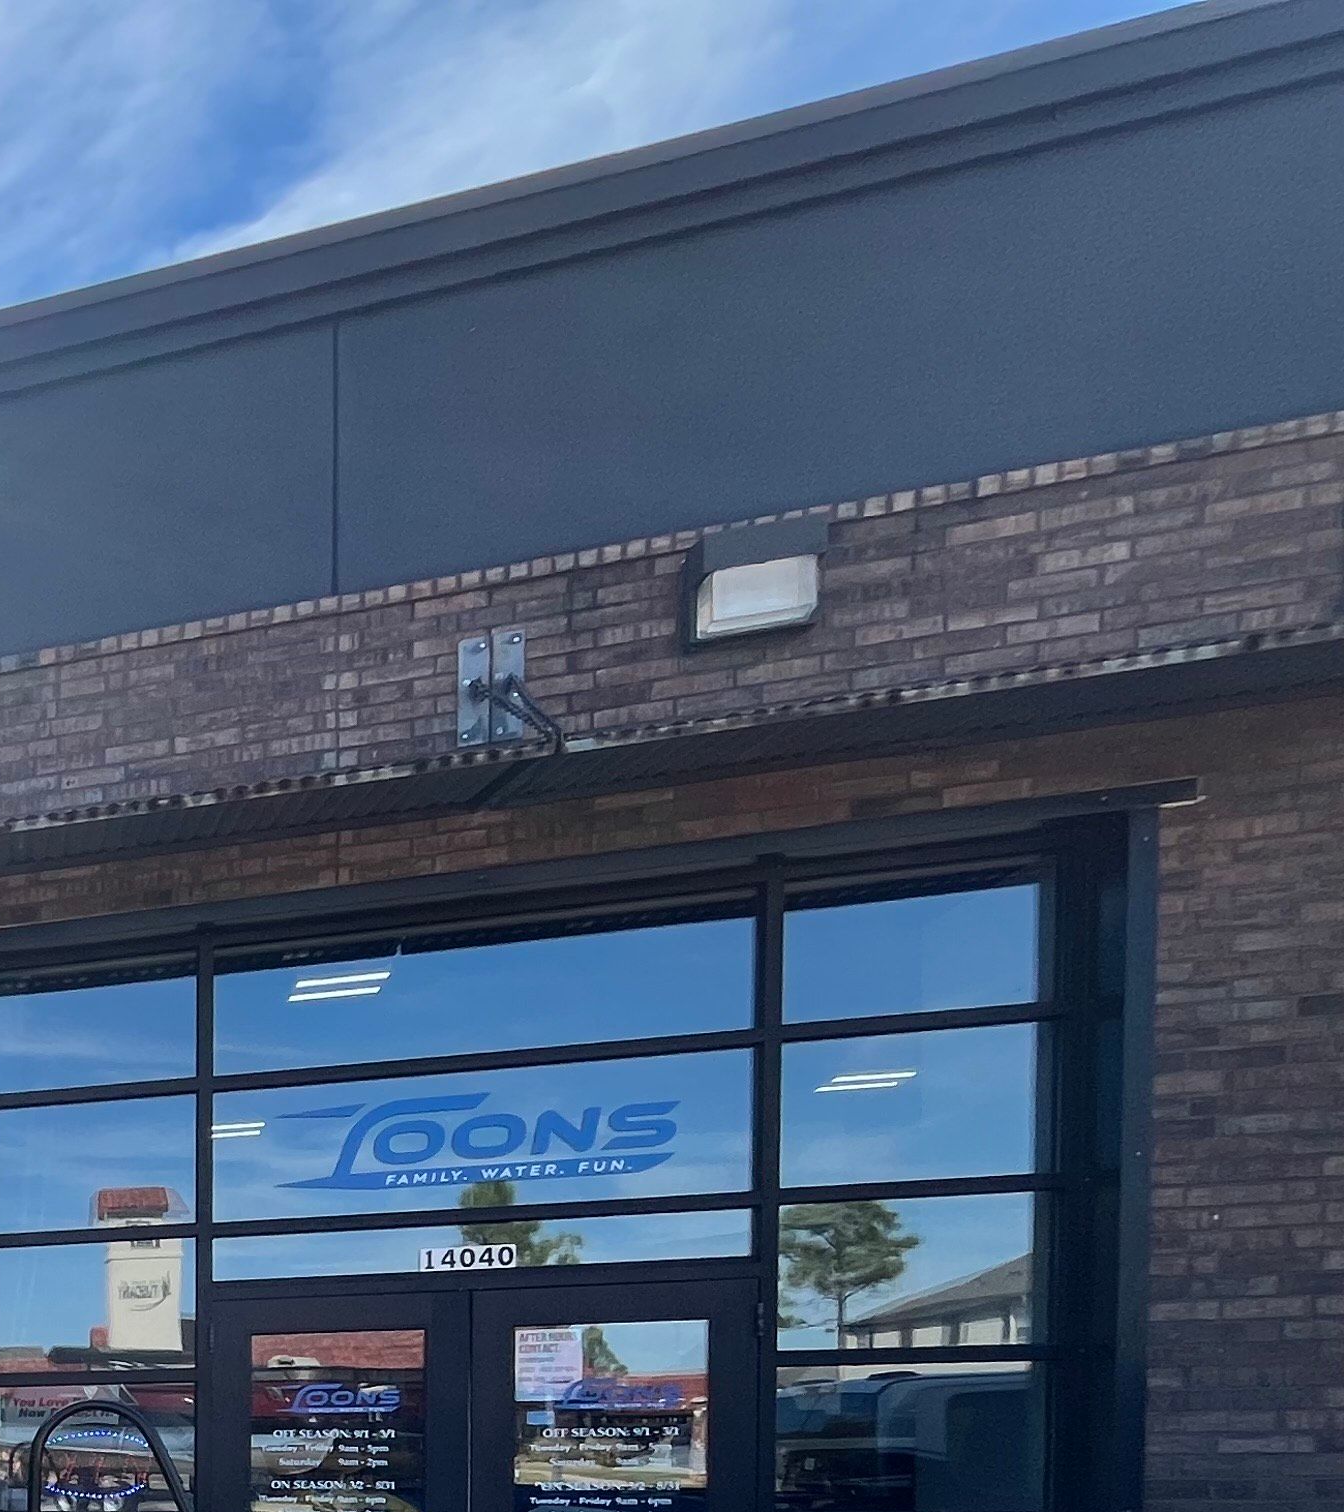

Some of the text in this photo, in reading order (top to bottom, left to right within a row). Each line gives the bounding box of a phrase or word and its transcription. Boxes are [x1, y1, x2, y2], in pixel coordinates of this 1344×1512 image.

[274, 1092, 680, 1176] TOONS
[385, 1159, 632, 1187] FAMILY. WATER. FUN.
[424, 1246, 515, 1270] 14040
[276, 1383, 402, 1410] TOONS
[272, 1428, 296, 1439] OFF
[542, 1427, 568, 1438] OFF
[270, 1480, 290, 1490] ON
